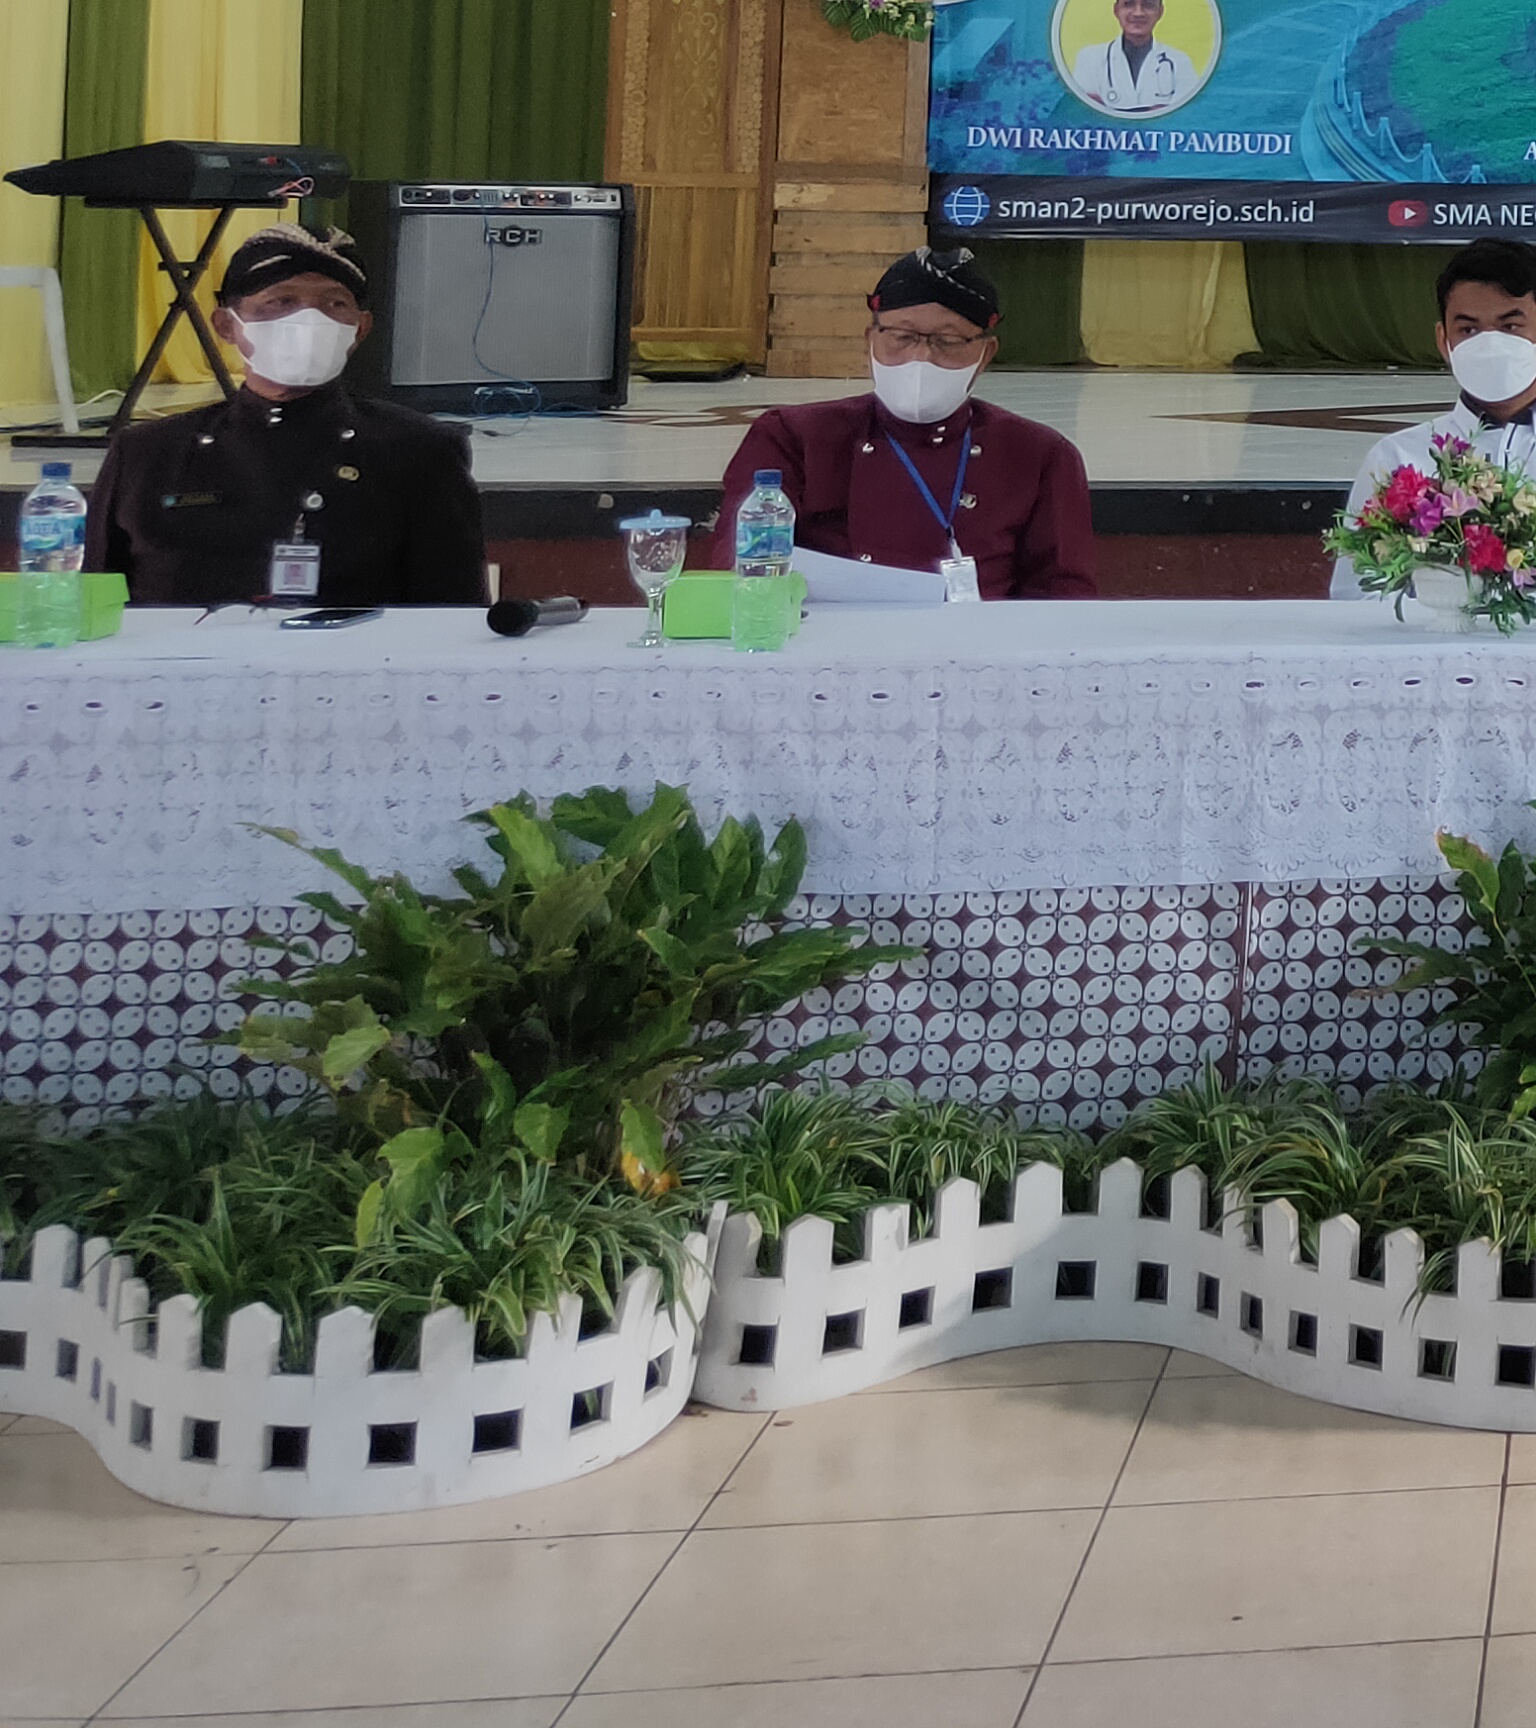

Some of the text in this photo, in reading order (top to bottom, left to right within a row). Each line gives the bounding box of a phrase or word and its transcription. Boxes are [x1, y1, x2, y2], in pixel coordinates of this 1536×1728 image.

[966, 125, 1293, 154] DWI RAKHMAT PAMBUDI
[998, 197, 1316, 226] sman2-purworejo.sch.id
[1432, 203, 1493, 227] SMA
